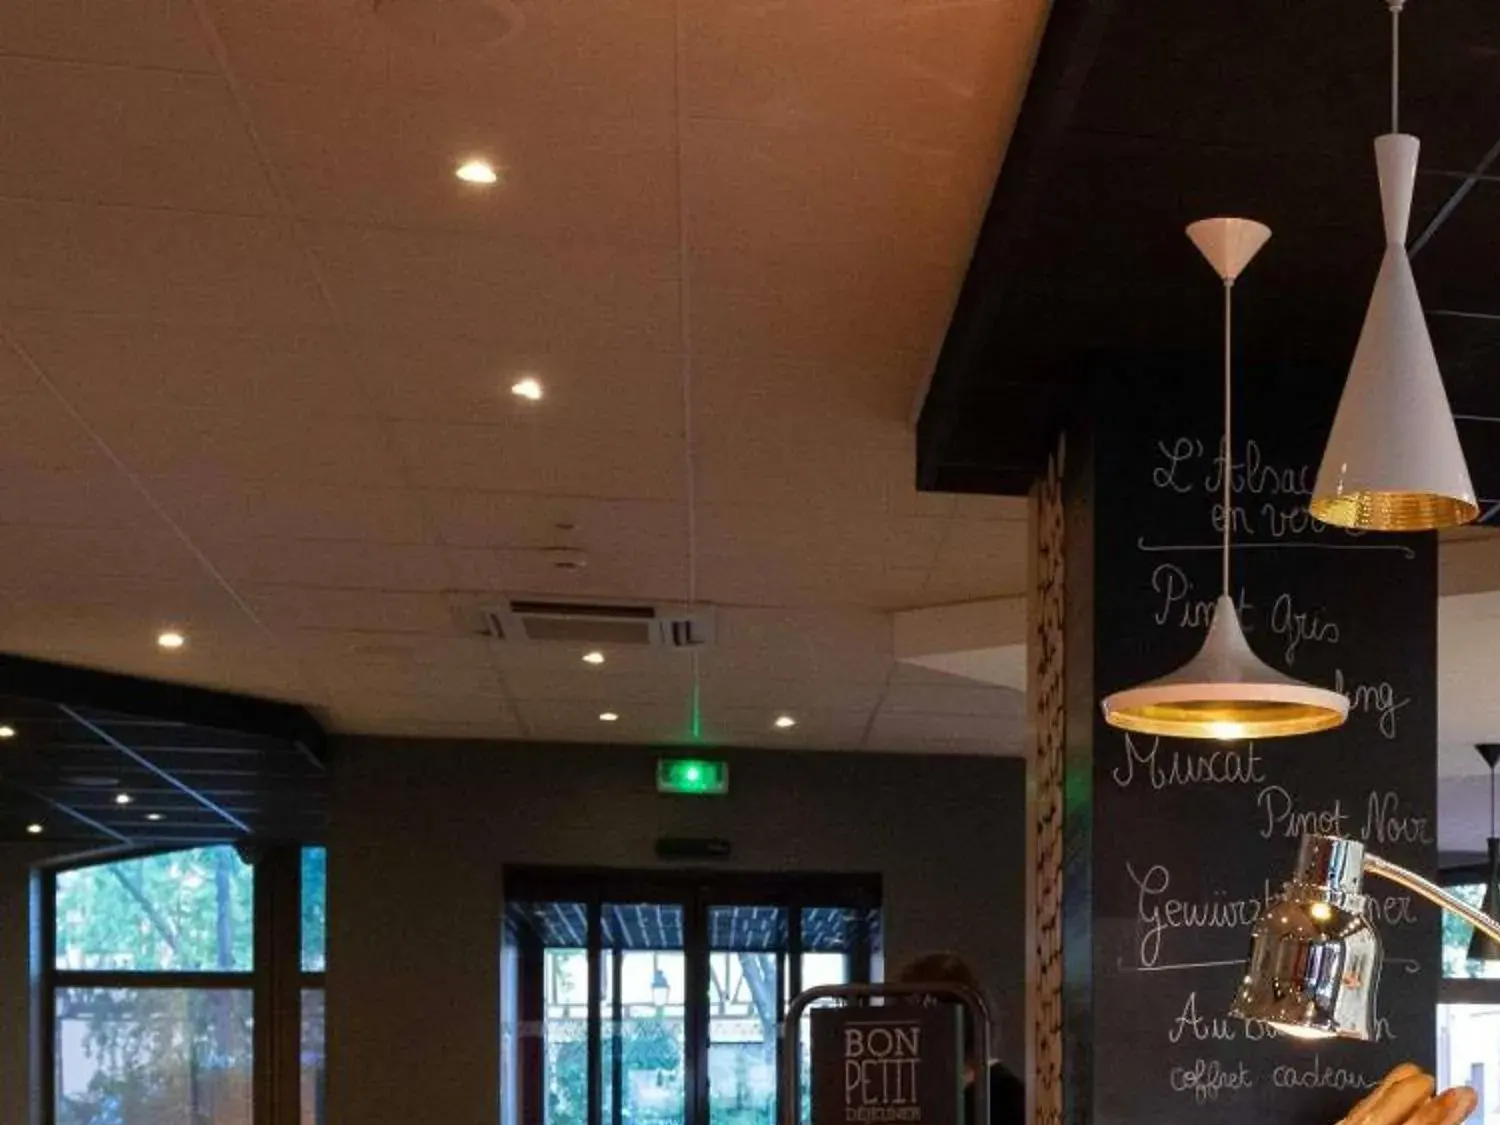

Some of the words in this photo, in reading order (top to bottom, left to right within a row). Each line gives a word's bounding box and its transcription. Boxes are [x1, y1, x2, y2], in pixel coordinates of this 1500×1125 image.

[1151, 563, 1255, 633] Pint
[1113, 731, 1266, 790] Muscat
[844, 1027, 922, 1058] BON
[845, 1057, 922, 1105] PETIT
